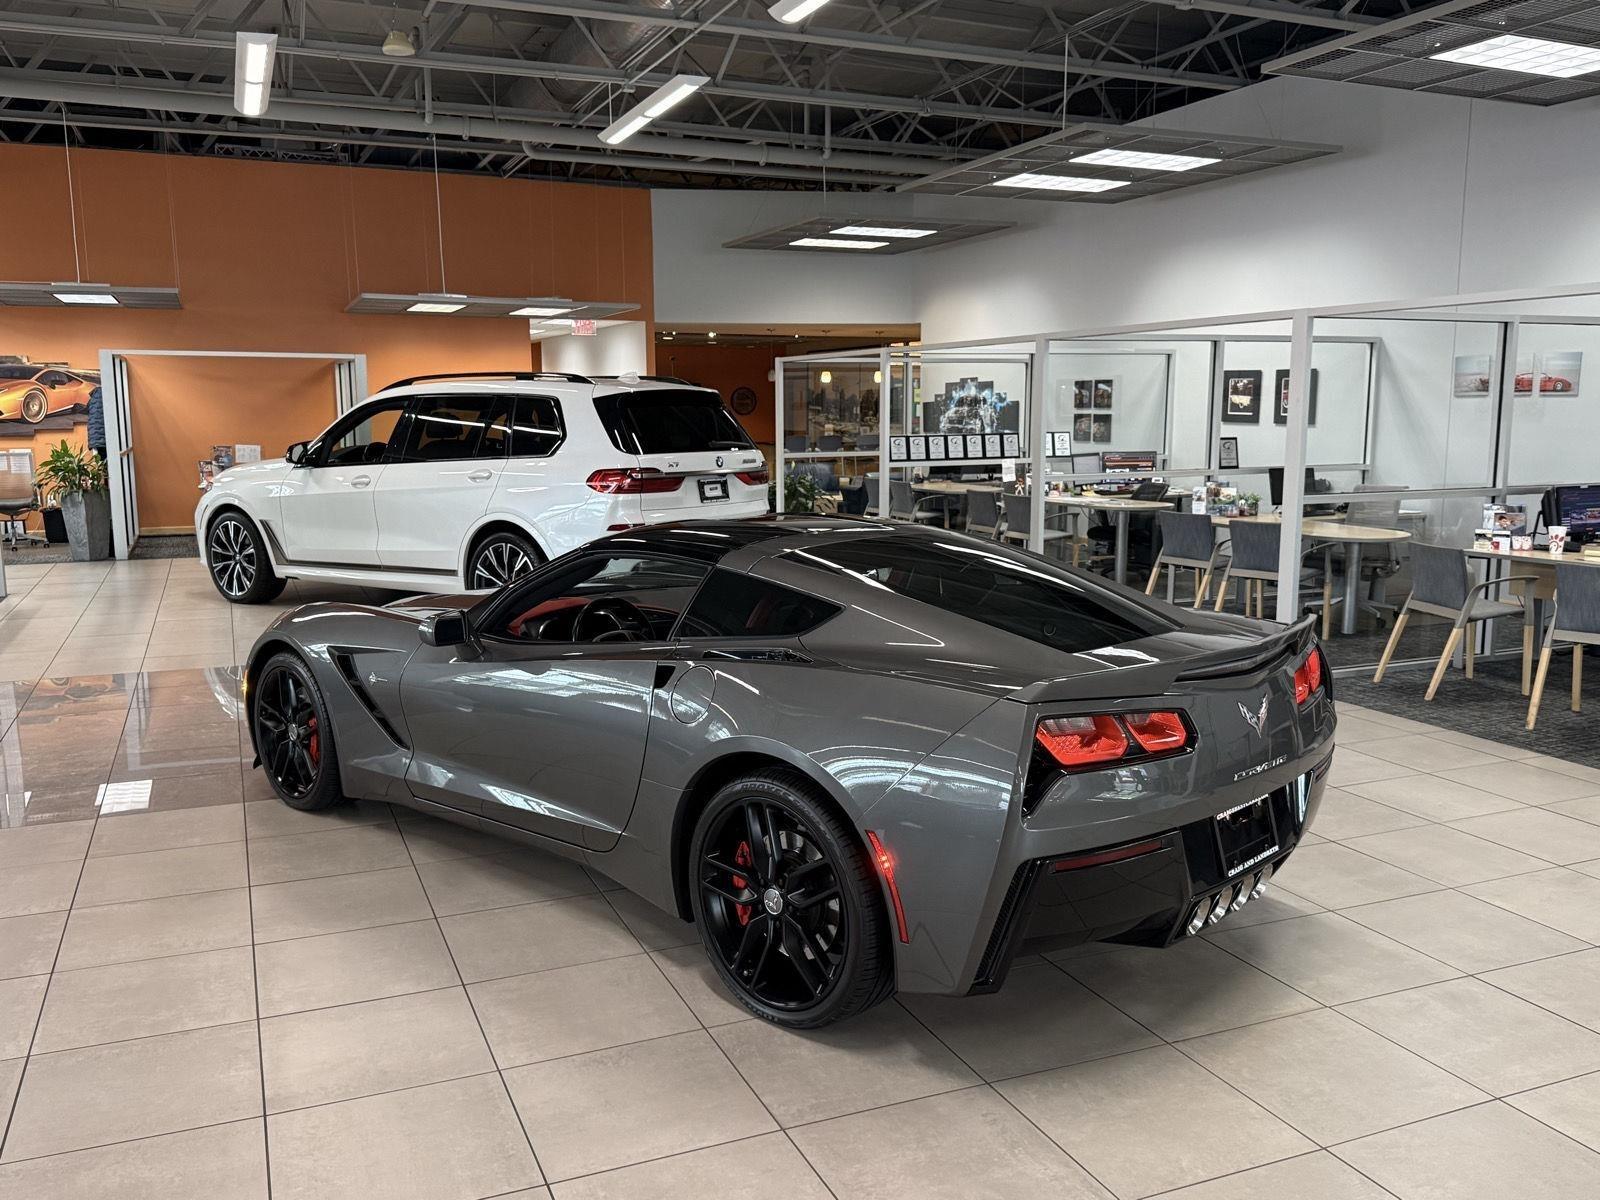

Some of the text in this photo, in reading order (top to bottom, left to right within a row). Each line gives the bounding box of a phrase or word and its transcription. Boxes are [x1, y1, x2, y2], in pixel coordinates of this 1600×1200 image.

[1228, 845, 1280, 877] CRAIG AND LANDRETH
